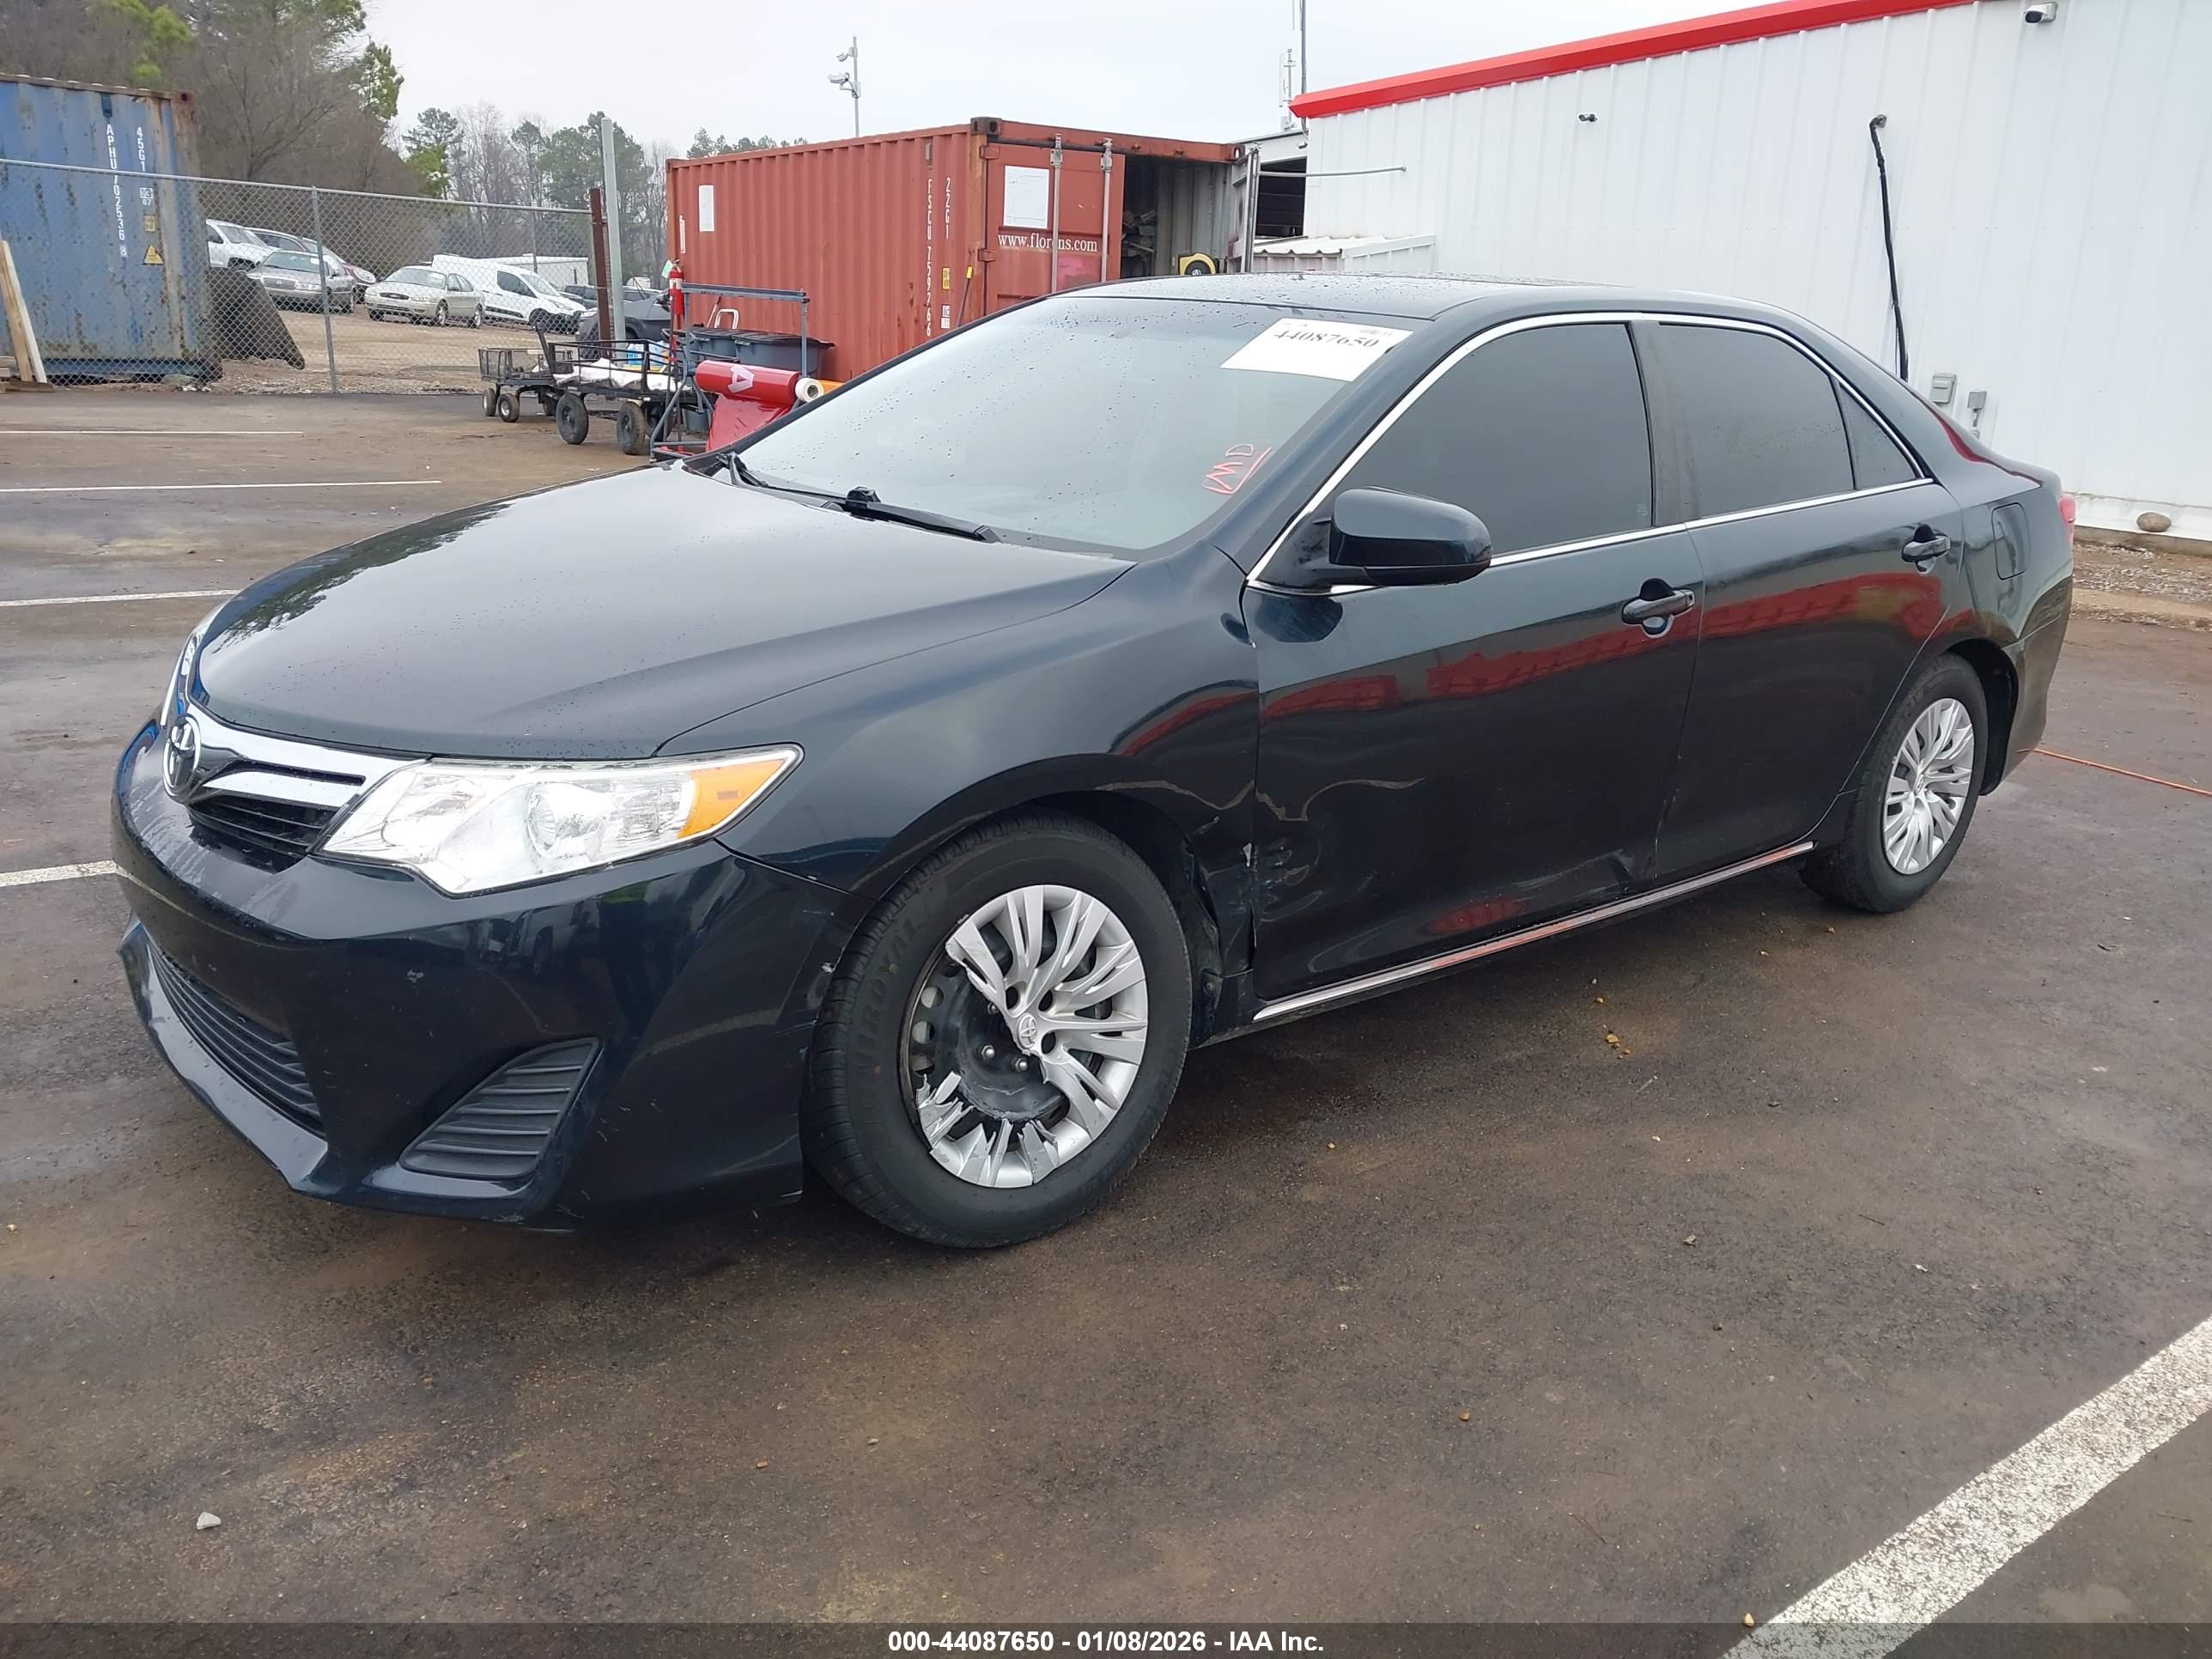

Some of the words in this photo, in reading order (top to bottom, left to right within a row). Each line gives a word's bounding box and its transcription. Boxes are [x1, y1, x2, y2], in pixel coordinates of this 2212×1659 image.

[106, 124, 118, 170] APHU
[137, 126, 146, 173] 45G1
[998, 233, 1097, 252] www.florns.com
[1273, 330, 1380, 348] 44087650
